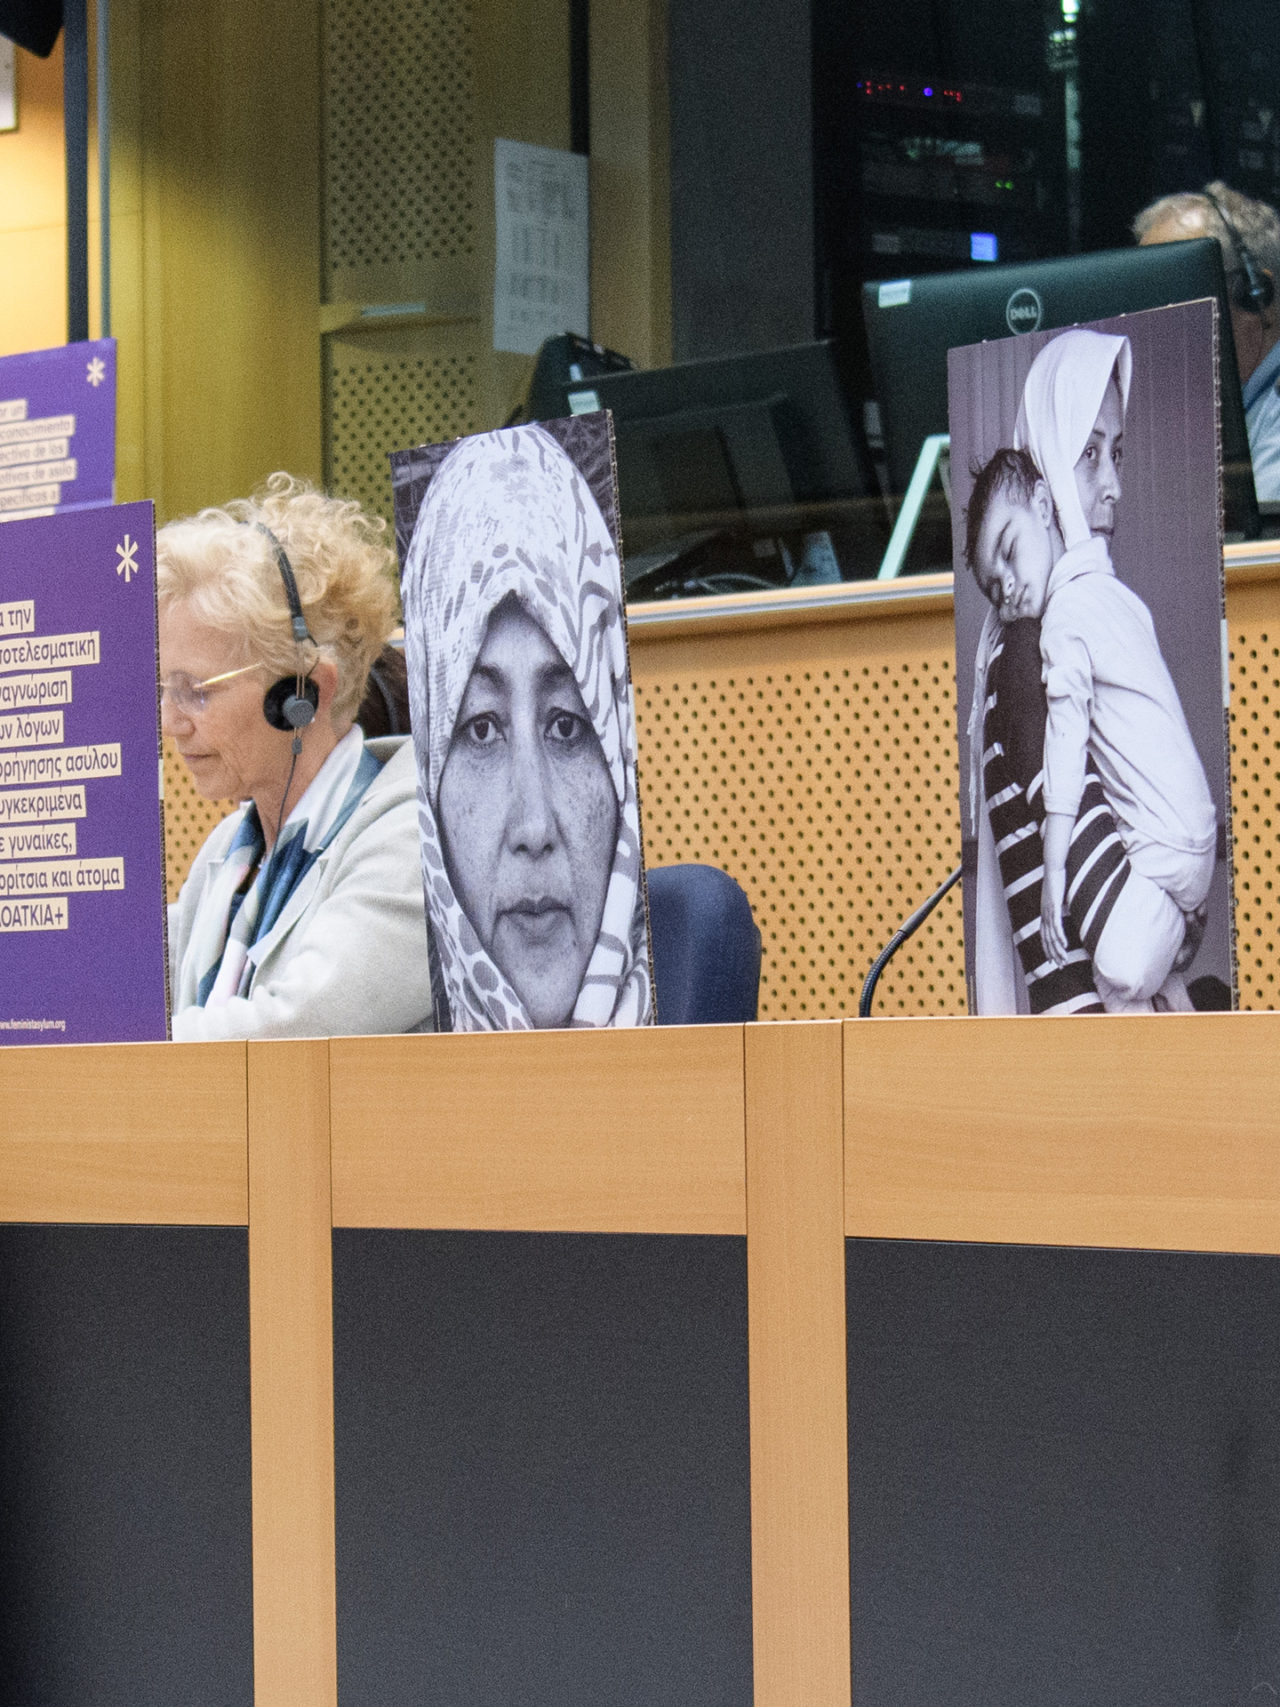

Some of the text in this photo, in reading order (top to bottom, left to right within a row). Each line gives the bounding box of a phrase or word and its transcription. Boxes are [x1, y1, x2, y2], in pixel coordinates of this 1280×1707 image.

[1010, 306, 1037, 321] DELL
[7, 606, 31, 631] την
[16, 713, 60, 743] λόγων
[65, 745, 118, 771] ασύλου
[8, 825, 73, 858] γυναίκες,
[51, 869, 73, 888] και
[76, 860, 121, 890] άτομα
